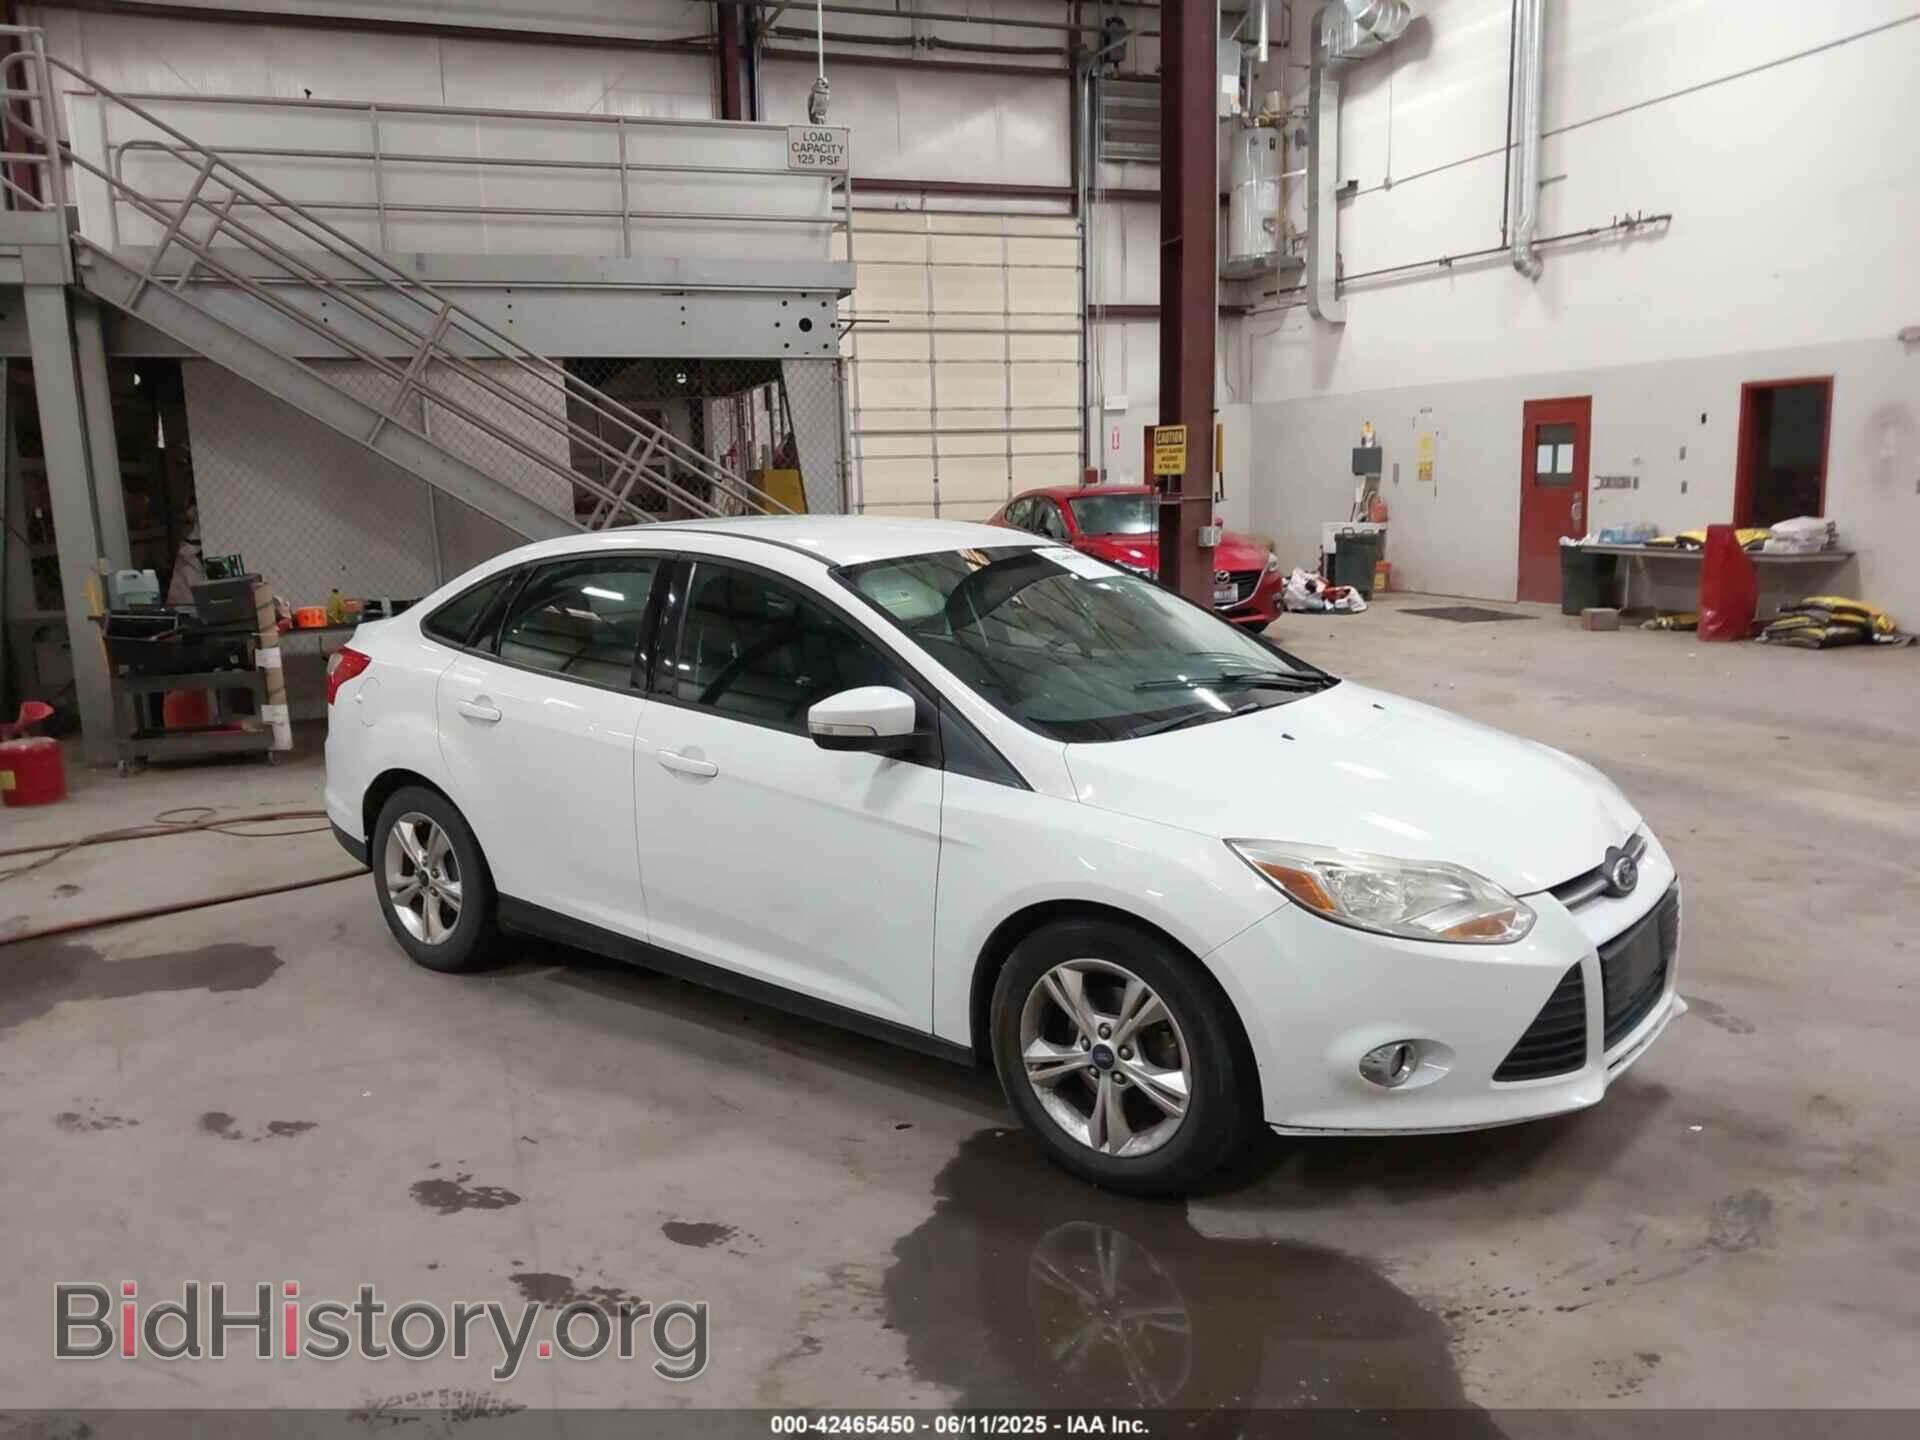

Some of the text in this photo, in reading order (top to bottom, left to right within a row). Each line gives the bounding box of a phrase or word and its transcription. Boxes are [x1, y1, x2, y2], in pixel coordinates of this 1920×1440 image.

[803, 132, 832, 142] LOAD
[791, 142, 844, 154] CAPACITY
[798, 154, 840, 165] 125 PSF
[1157, 431, 1184, 444] CAUTION
